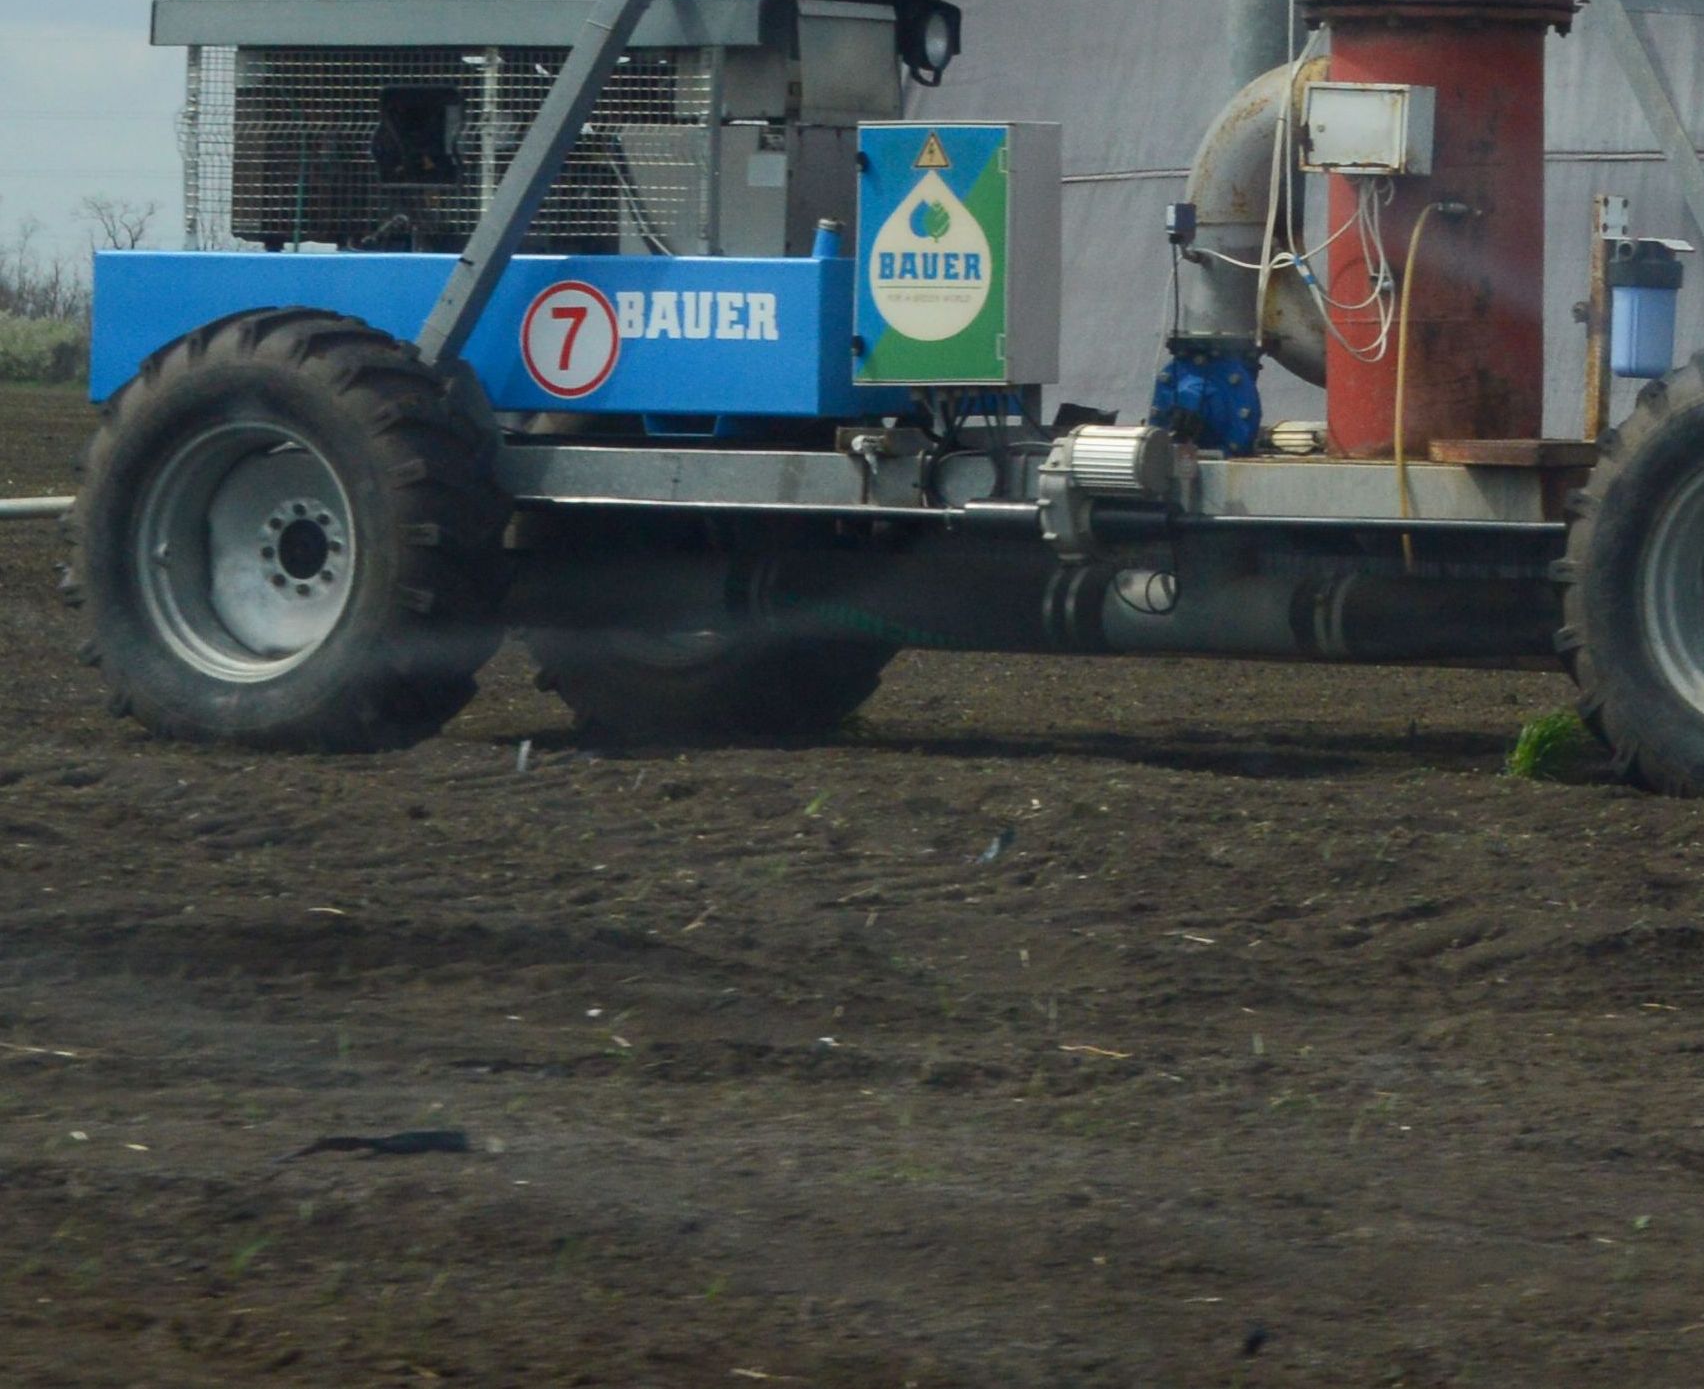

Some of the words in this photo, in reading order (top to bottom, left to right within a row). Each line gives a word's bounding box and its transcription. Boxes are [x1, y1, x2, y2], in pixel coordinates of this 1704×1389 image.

[879, 252, 982, 280] BAUER
[551, 306, 588, 371] 7
[616, 291, 779, 341] BAUER
